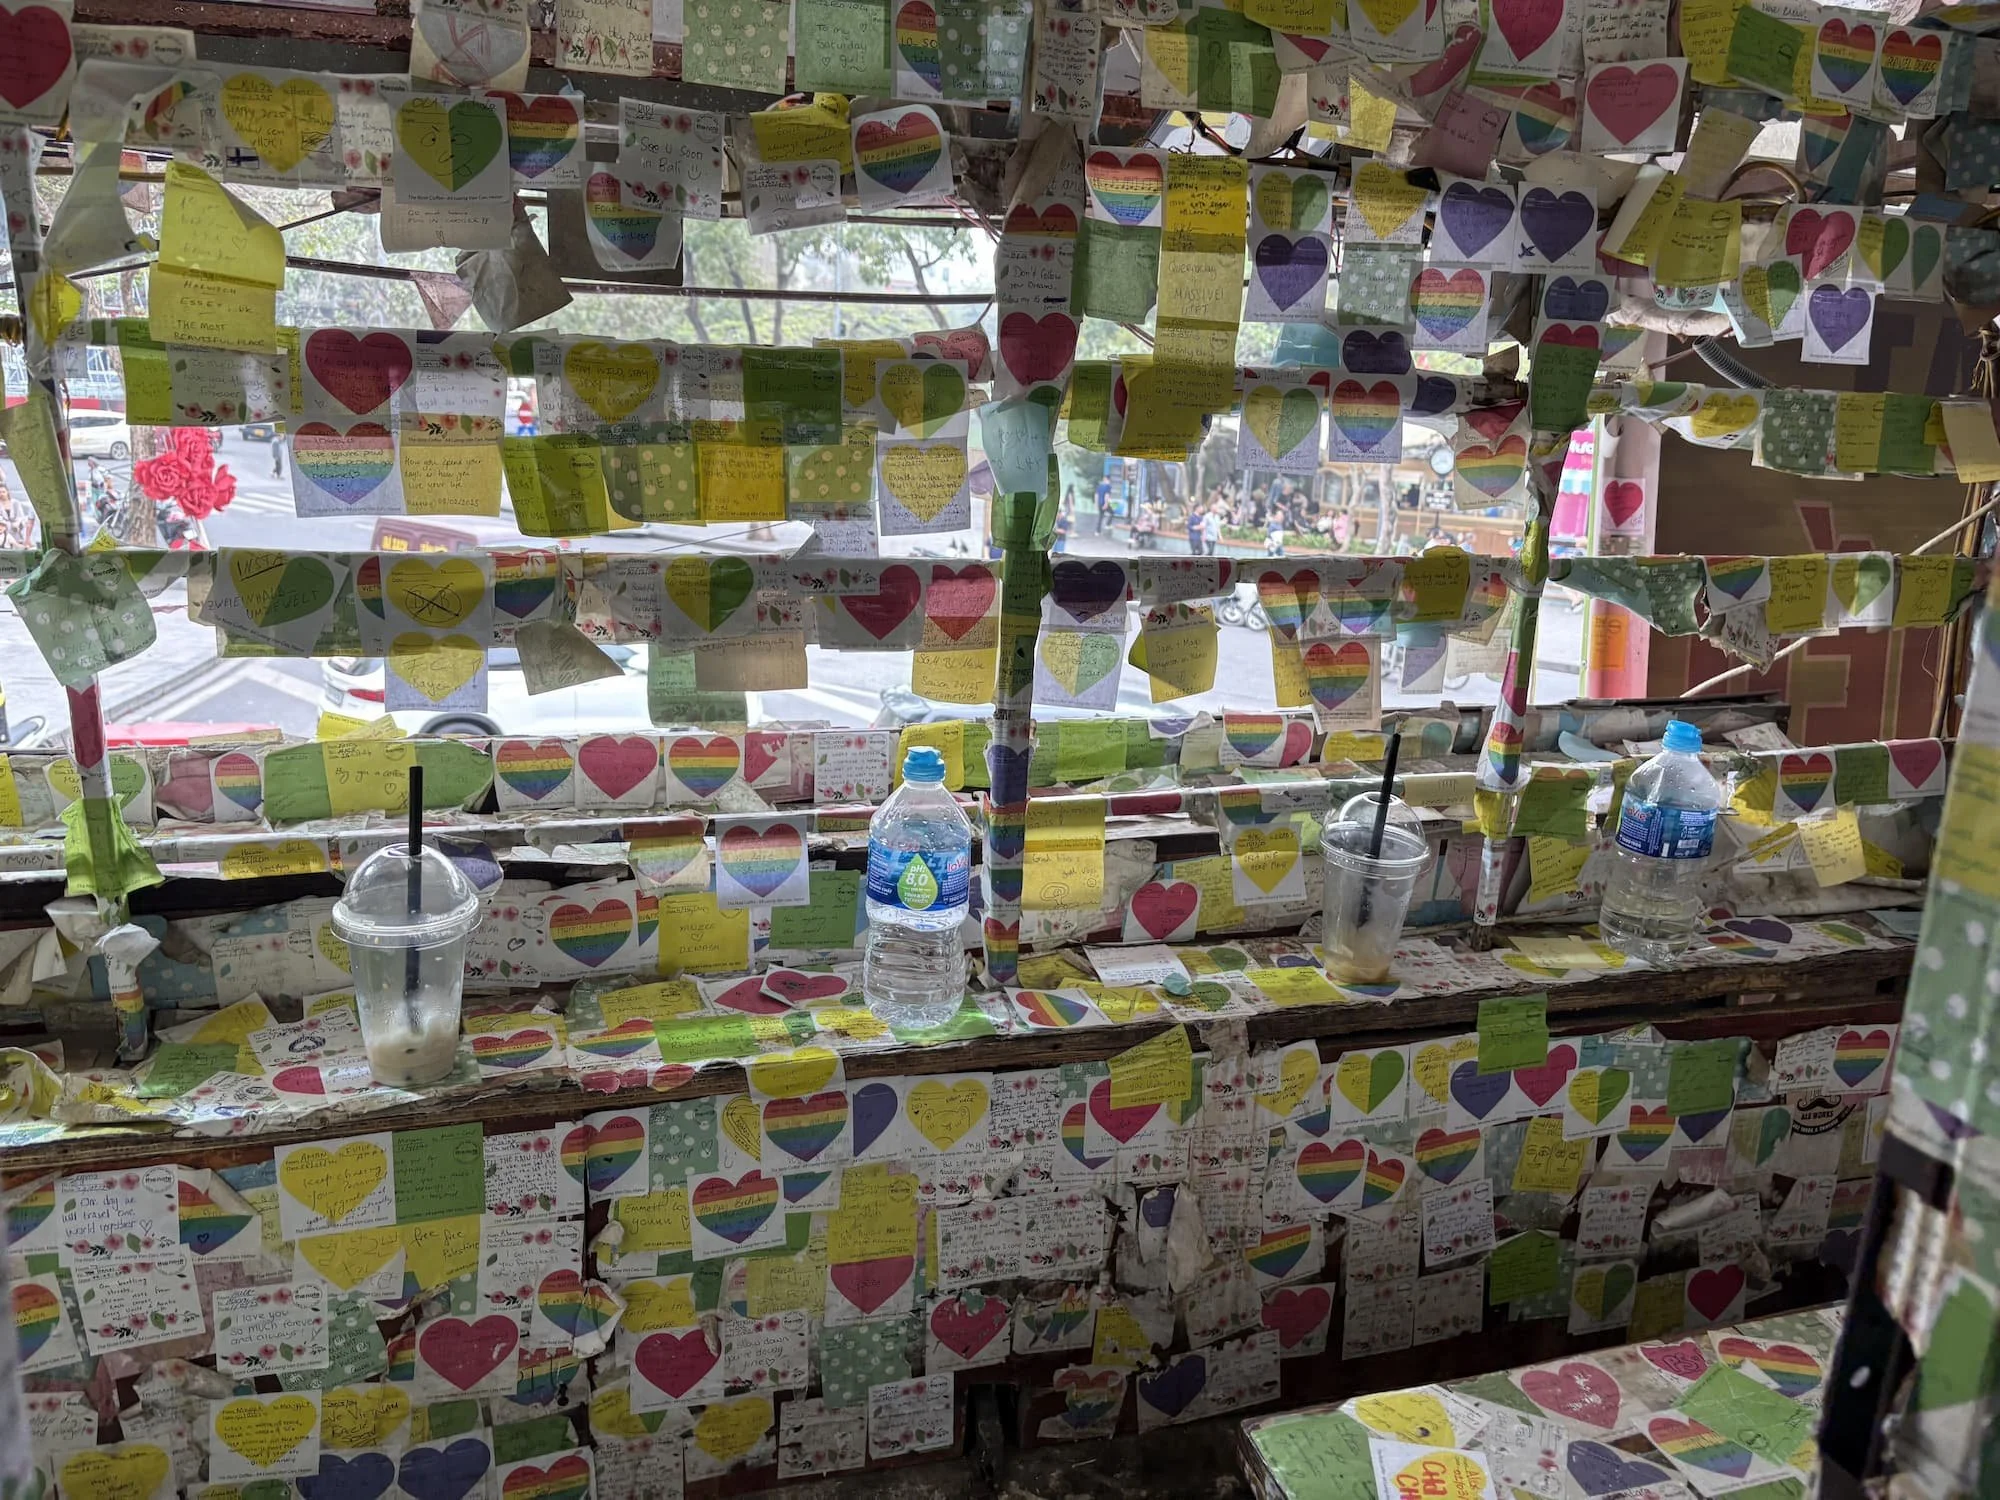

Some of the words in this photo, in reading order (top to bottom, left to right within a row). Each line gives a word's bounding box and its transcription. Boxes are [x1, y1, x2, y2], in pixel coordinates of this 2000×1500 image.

[641, 137, 659, 153] See
[680, 144, 704, 160] Soon
[657, 158, 681, 172] Bali
[176, 320, 198, 330] THE
[200, 321, 227, 331] MOST
[404, 457, 420, 465] How
[906, 873, 929, 887] 8,0
[104, 1194, 119, 1211] day
[242, 1311, 267, 1322] love
[270, 1310, 290, 1323] you
[230, 1328, 245, 1338] so
[249, 1323, 280, 1333] much
[230, 1335, 253, 1346] and
[764, 1335, 790, 1347] down
